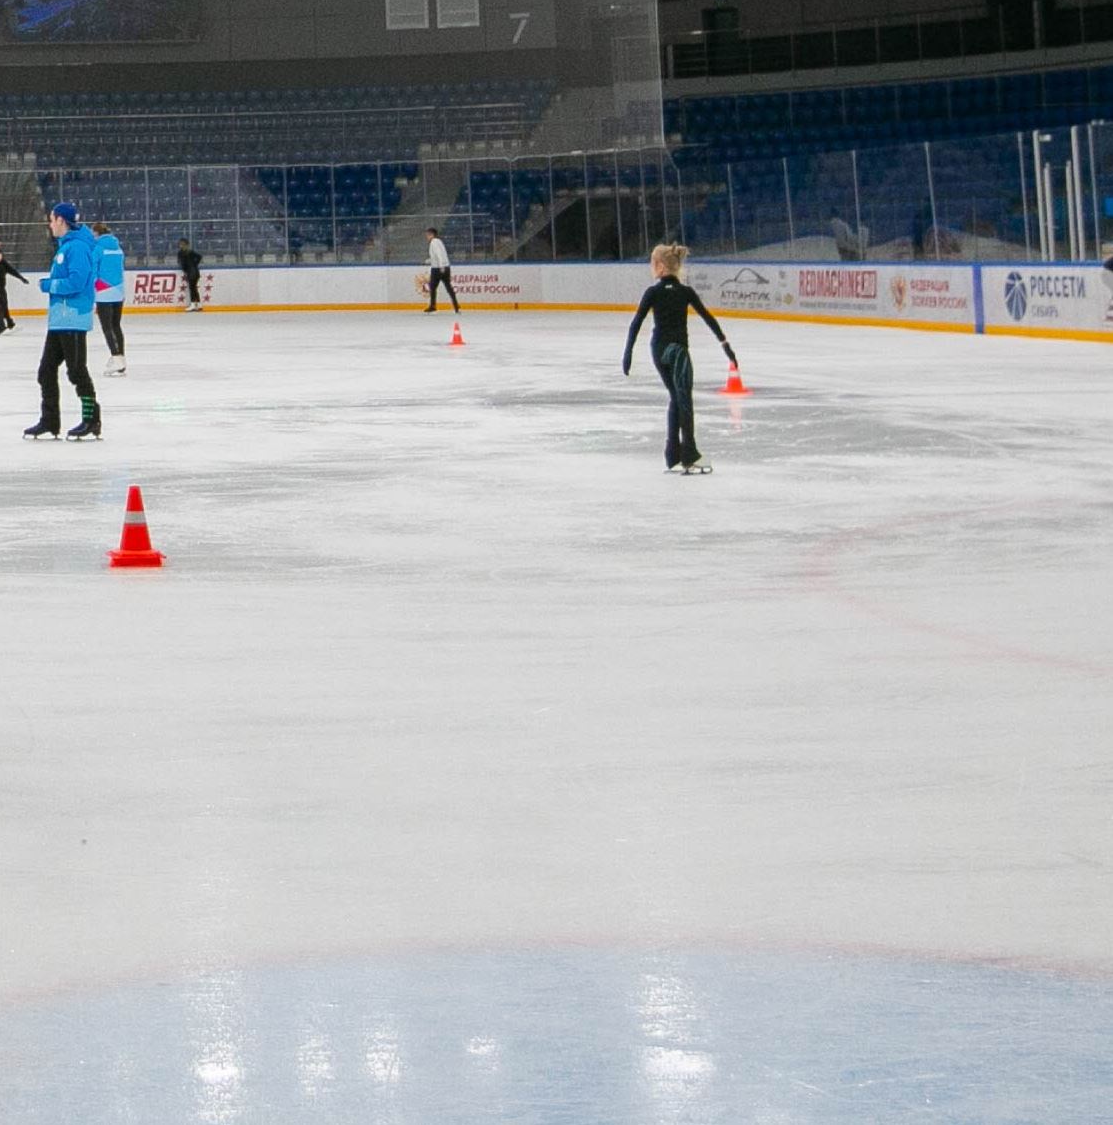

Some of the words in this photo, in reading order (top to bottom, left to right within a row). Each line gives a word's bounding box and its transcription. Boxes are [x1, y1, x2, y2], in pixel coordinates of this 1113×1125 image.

[509, 12, 530, 44] 7
[134, 273, 176, 293] RED
[452, 274, 499, 284] ЕДЕРАЦИЯ
[1030, 275, 1086, 298] РОССЕТИ
[452, 285, 483, 294] ОККЕЯ
[485, 285, 520, 294] РОССИИ
[133, 294, 175, 304] MACHINE
